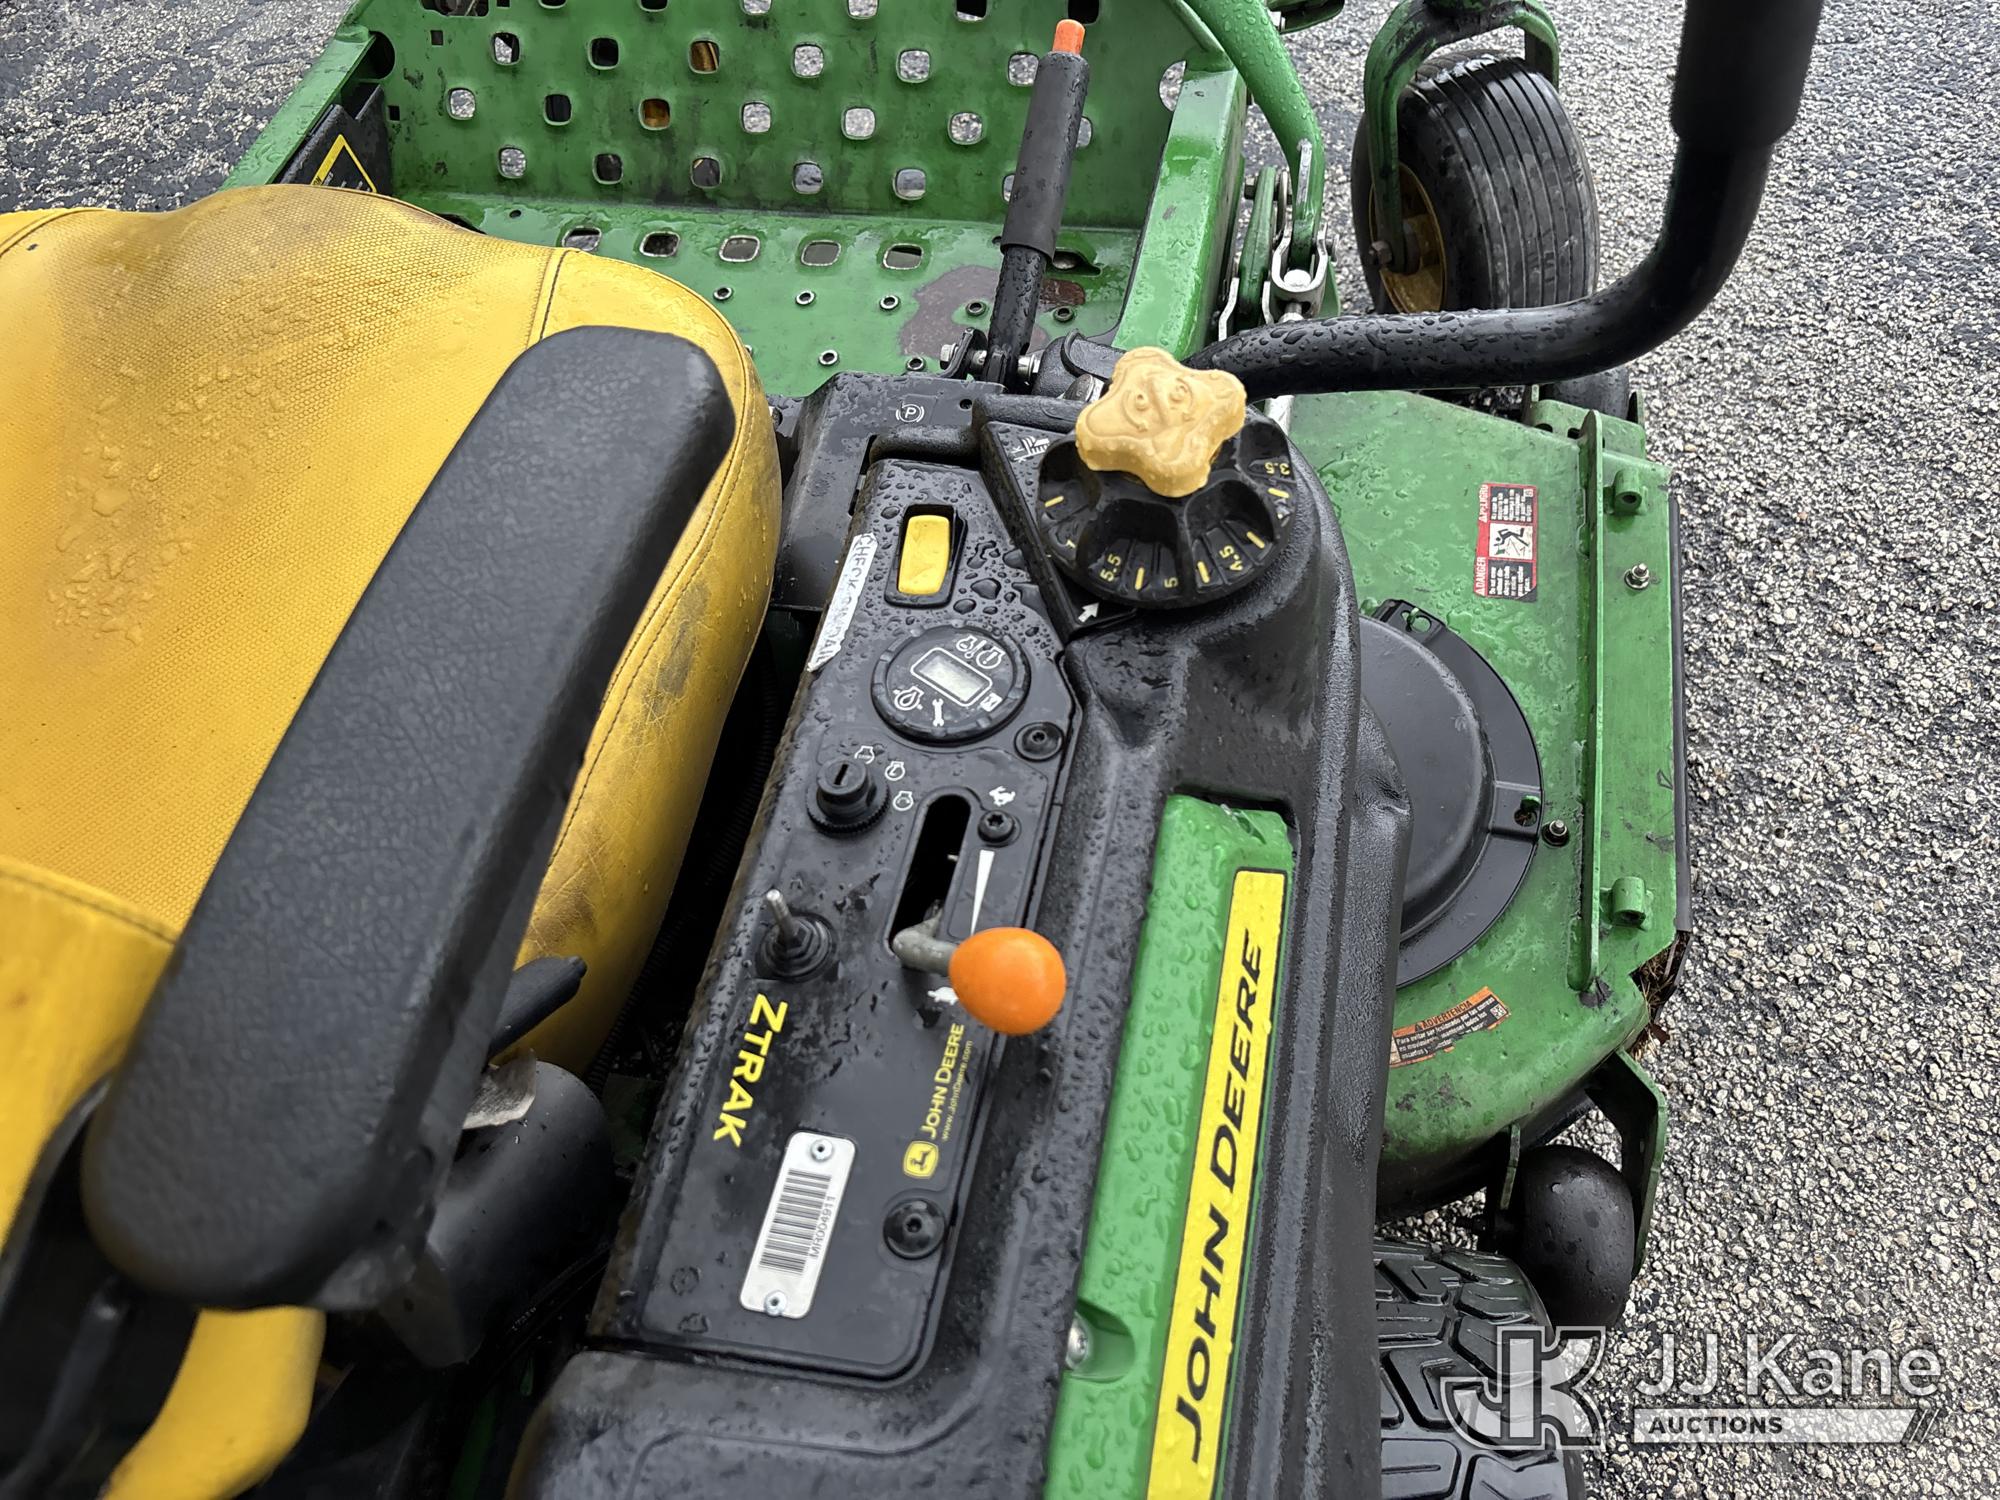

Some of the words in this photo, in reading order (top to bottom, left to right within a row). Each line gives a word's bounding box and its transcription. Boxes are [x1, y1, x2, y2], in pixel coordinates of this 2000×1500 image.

[1264, 462, 1291, 475] 3.5
[1100, 553, 1122, 582] 5.5
[1219, 545, 1244, 571] 4.5
[1475, 556, 1487, 588] DANGER
[1164, 577, 1179, 588] 5
[1422, 1000, 1473, 1028] ADVERTENCIA
[934, 1022, 965, 1084] DEERE
[713, 994, 788, 1147] ZTRAK
[920, 1086, 949, 1140] JOHN
[1176, 1202, 1229, 1464] JOHN
[1210, 928, 1261, 1194] DEERE
[809, 1195, 837, 1259] MR004911
